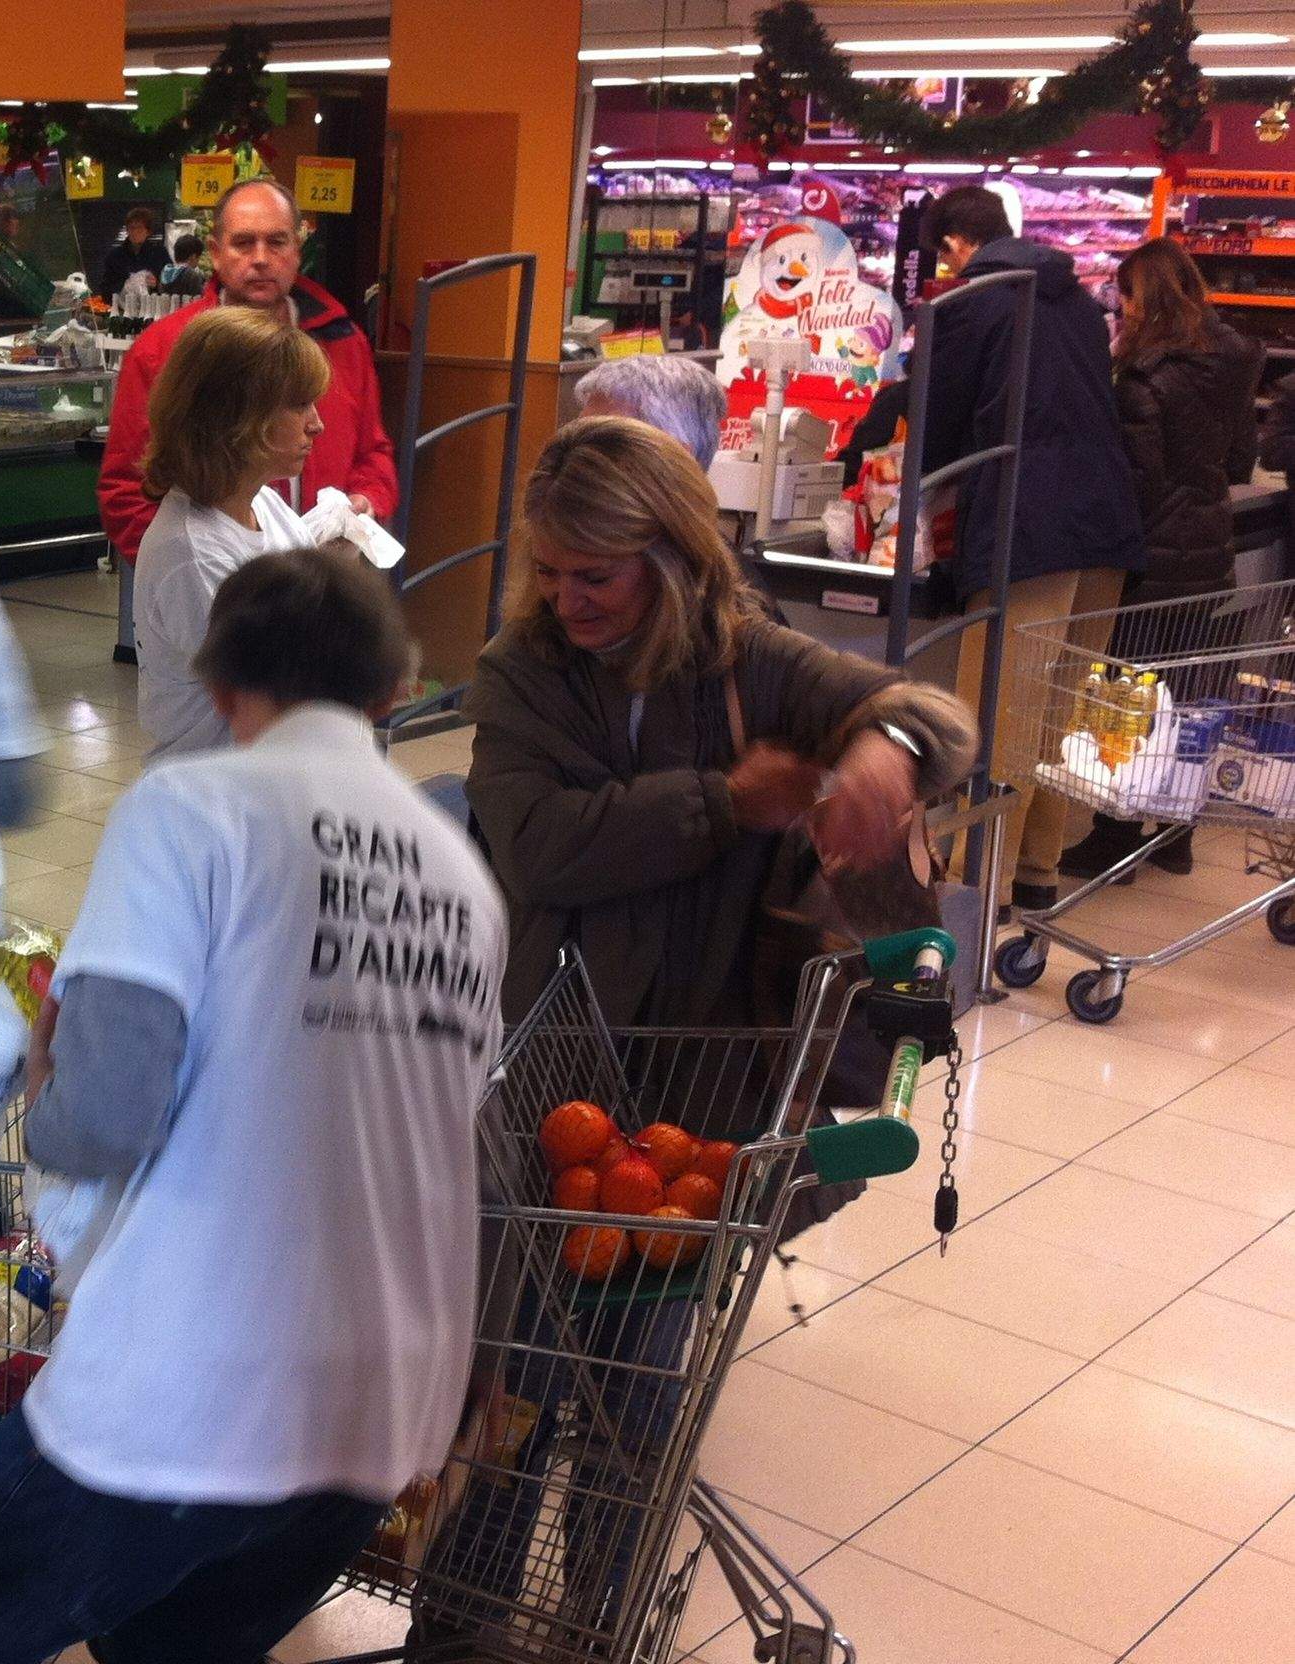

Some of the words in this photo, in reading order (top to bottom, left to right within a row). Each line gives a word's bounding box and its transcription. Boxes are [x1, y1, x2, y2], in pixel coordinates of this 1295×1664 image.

[798, 300, 876, 338] Navidad
[311, 809, 421, 878] GRAN
[319, 864, 471, 942] RECAPTE
